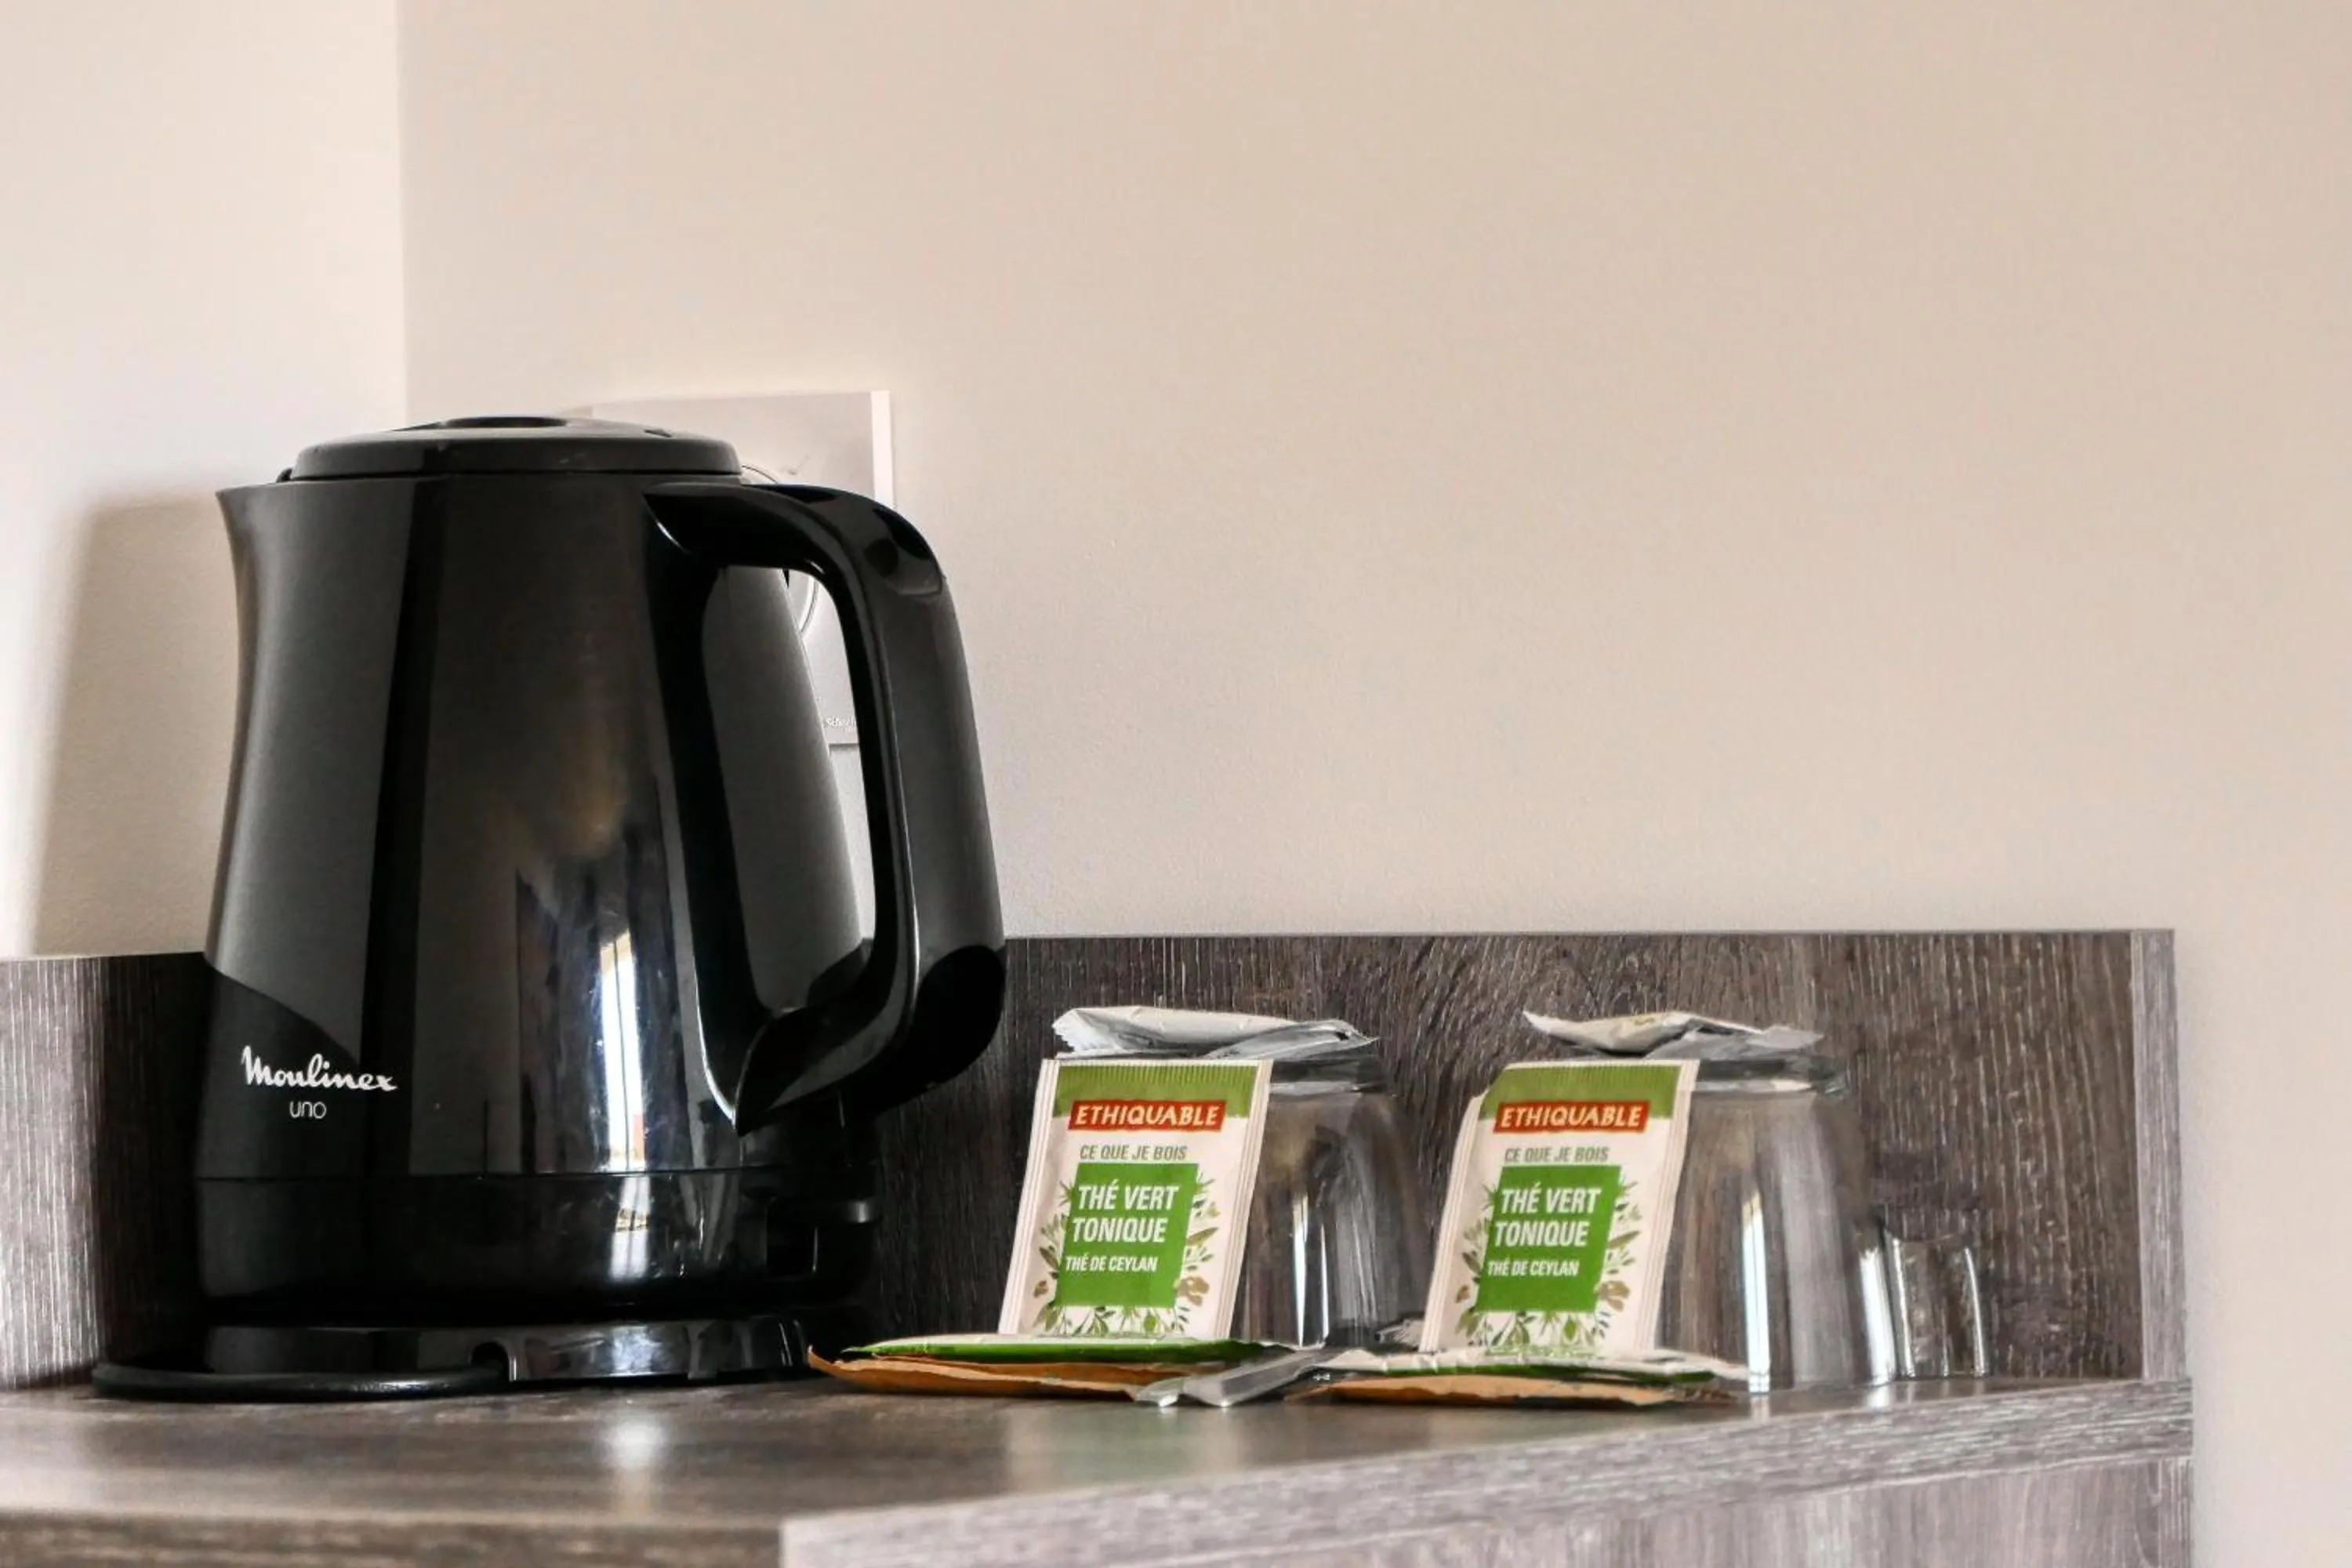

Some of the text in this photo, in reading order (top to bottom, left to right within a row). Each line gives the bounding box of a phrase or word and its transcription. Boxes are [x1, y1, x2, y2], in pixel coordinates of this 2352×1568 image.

[241, 1045, 397, 1091] Moulinex
[289, 1101, 327, 1119] uno
[1074, 1104, 1221, 1127] ETHIQUABLE
[1500, 1105, 1644, 1127] ETHIQUABLE
[1080, 1145, 1188, 1160] CE QUE JE BOIS
[1504, 1147, 1610, 1163] CE QUE JE BOIS
[1078, 1179, 1179, 1210] THÉ VERT
[1501, 1182, 1602, 1214] THÉ VERT
[1072, 1218, 1168, 1243] TONIQUE
[1494, 1221, 1591, 1247] TONIQUE
[1065, 1253, 1158, 1272] THÉ DE CEYLAN
[1510, 1260, 1529, 1276] DE
[1530, 1260, 1580, 1276] CEYLAN
